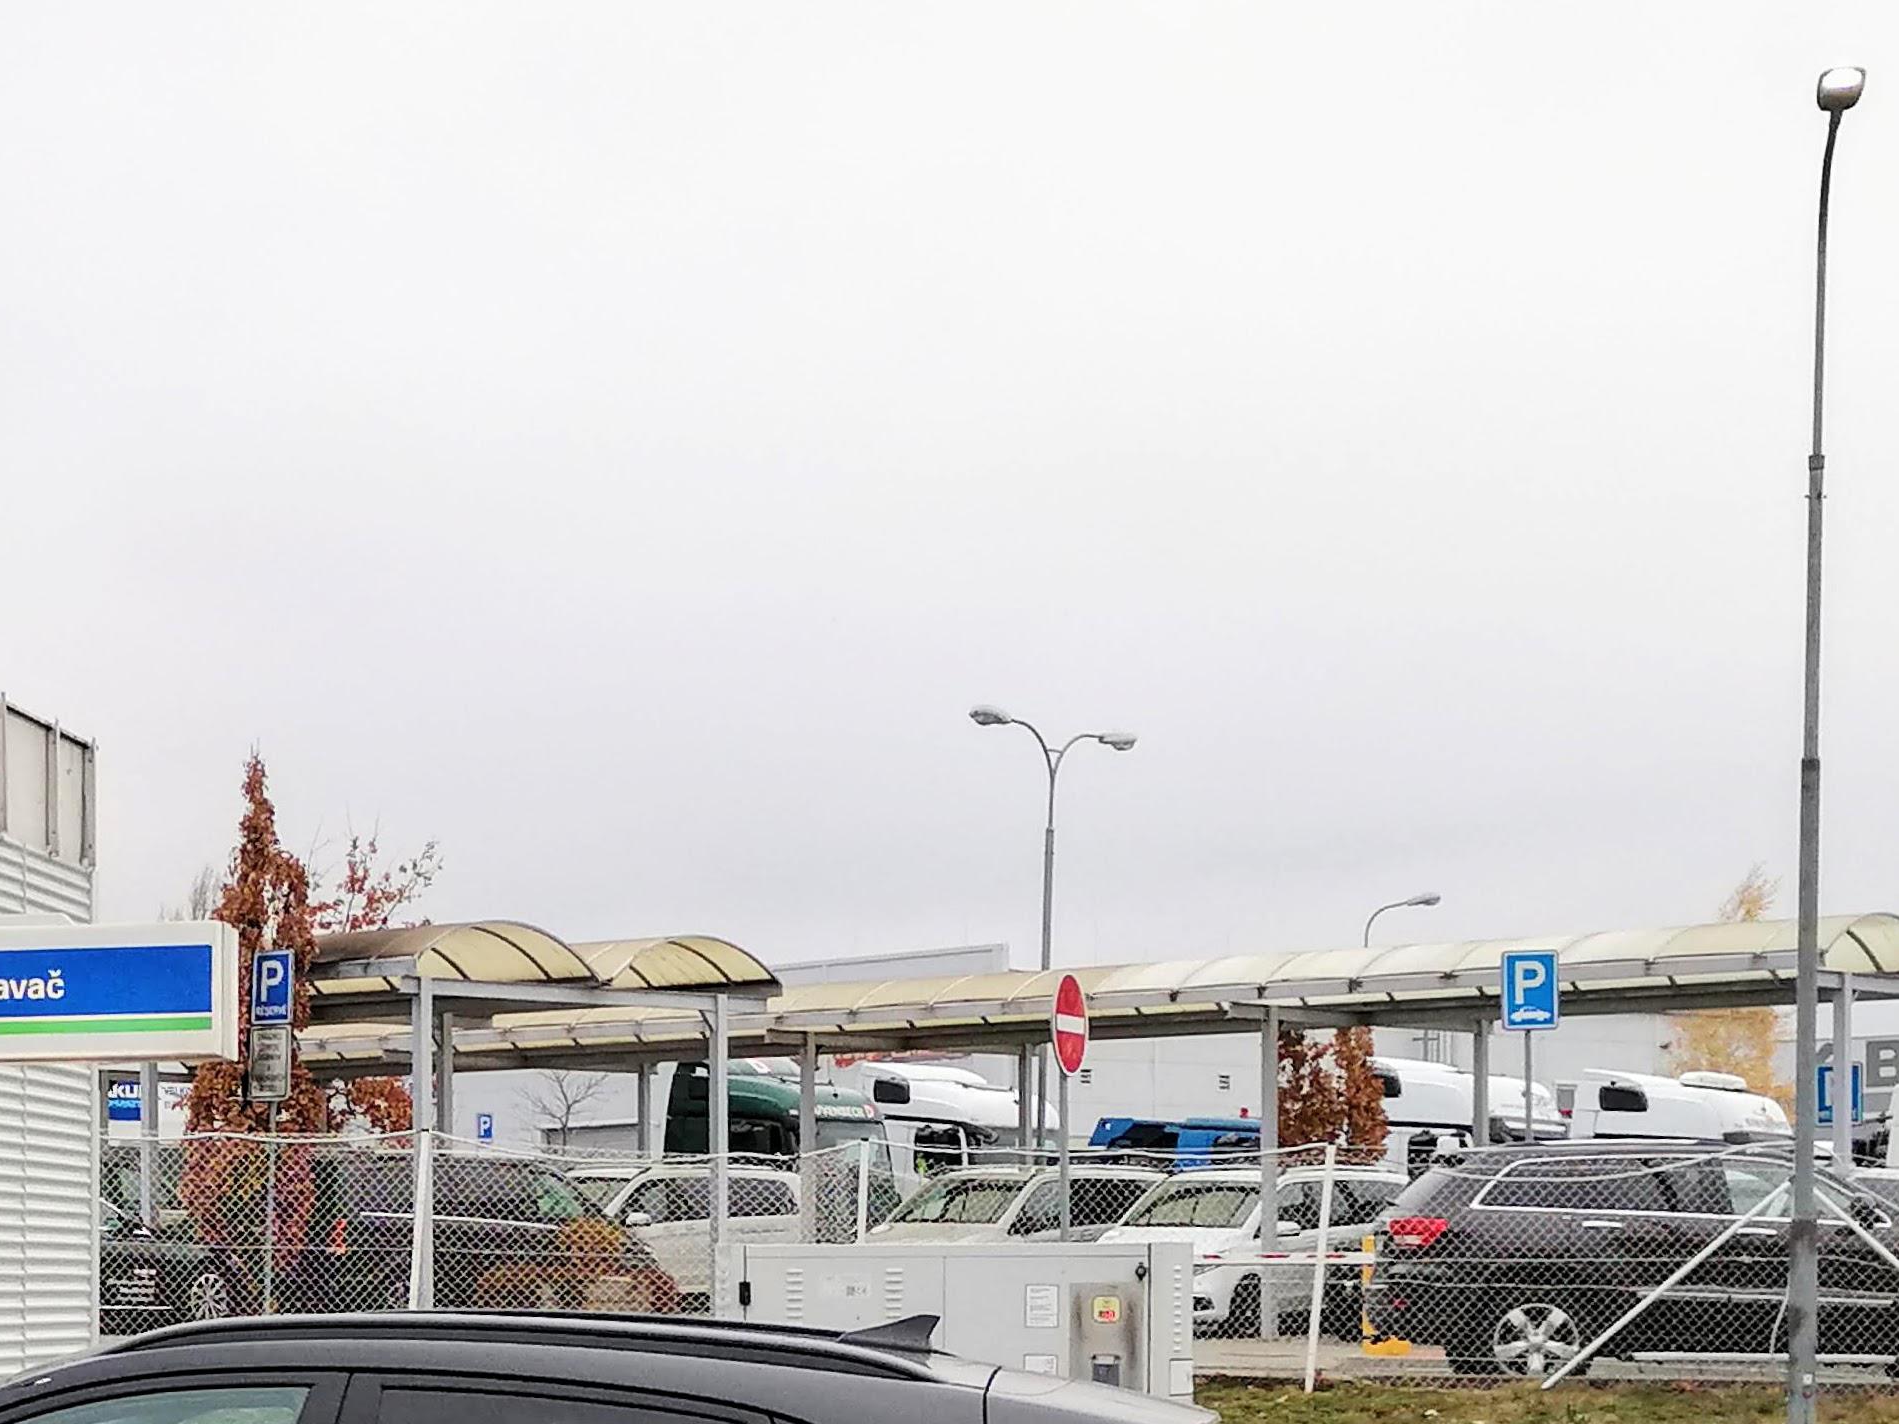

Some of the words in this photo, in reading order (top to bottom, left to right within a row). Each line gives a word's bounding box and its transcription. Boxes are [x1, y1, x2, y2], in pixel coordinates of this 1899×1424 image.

[261, 960, 284, 1002] P
[1515, 960, 1546, 1005] P
[480, 1116, 491, 1136] P
